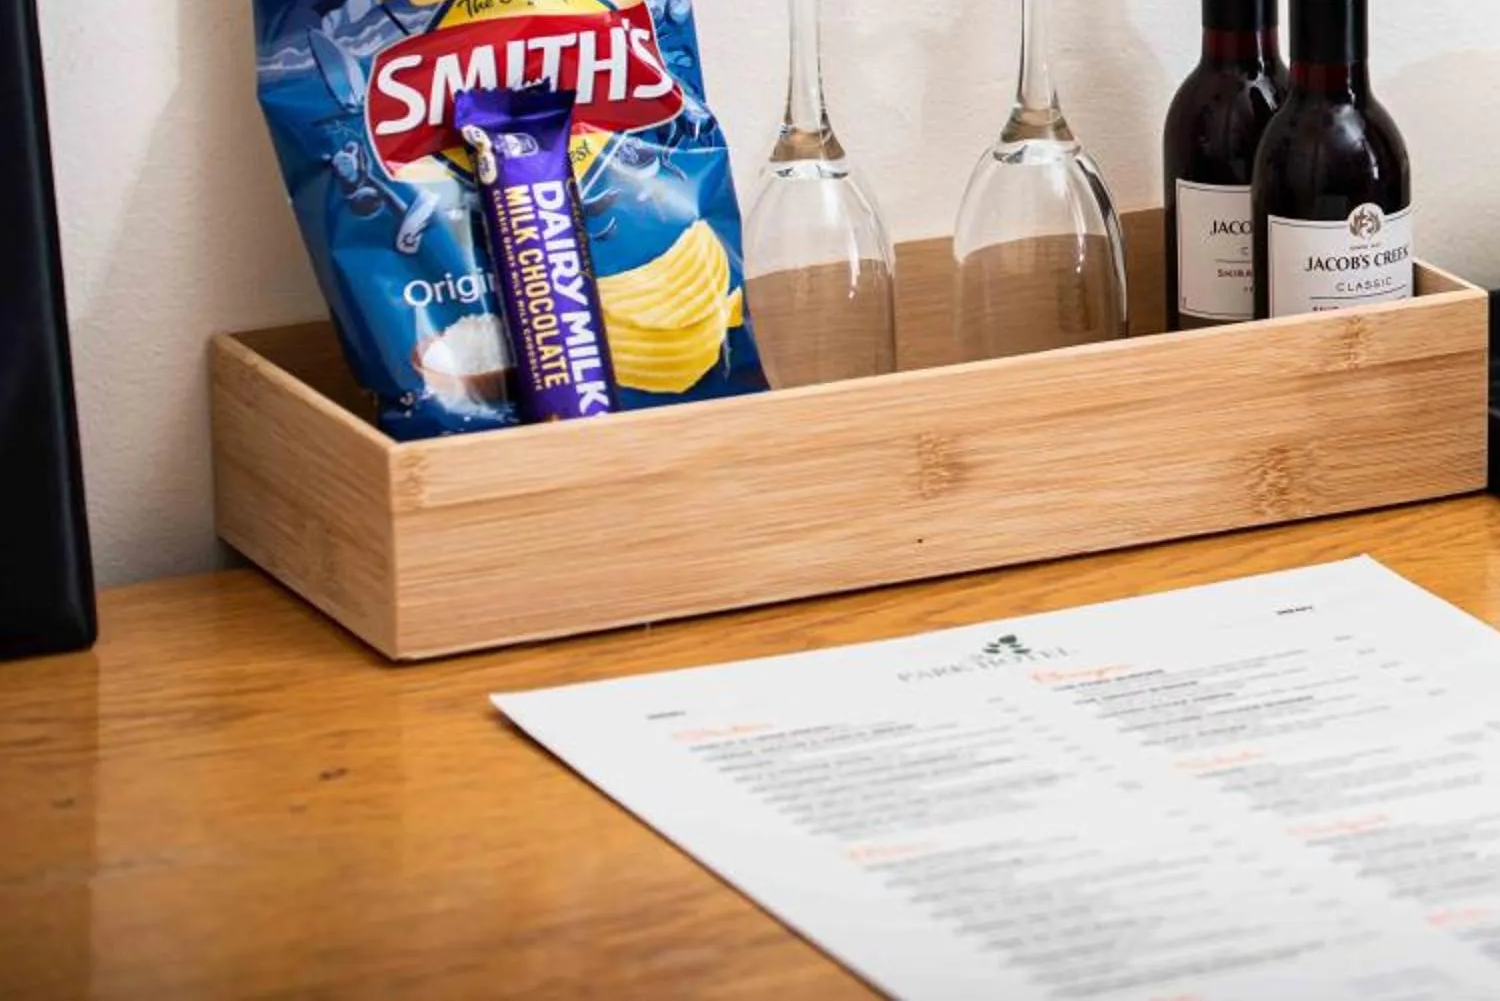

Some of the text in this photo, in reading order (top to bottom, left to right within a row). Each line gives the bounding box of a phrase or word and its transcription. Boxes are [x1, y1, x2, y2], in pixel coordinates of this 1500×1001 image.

[375, 19, 673, 135] SMITH'S
[504, 184, 540, 244] MILK
[1210, 219, 1253, 235] JACO
[1304, 254, 1371, 272] JACOB'S
[1335, 276, 1393, 292] CLASSIC
[518, 248, 570, 389] CHOCOLATE
[531, 180, 588, 306] DAIRY
[561, 310, 610, 415] MILK
[523, 327, 543, 391] CHOCOLATE
